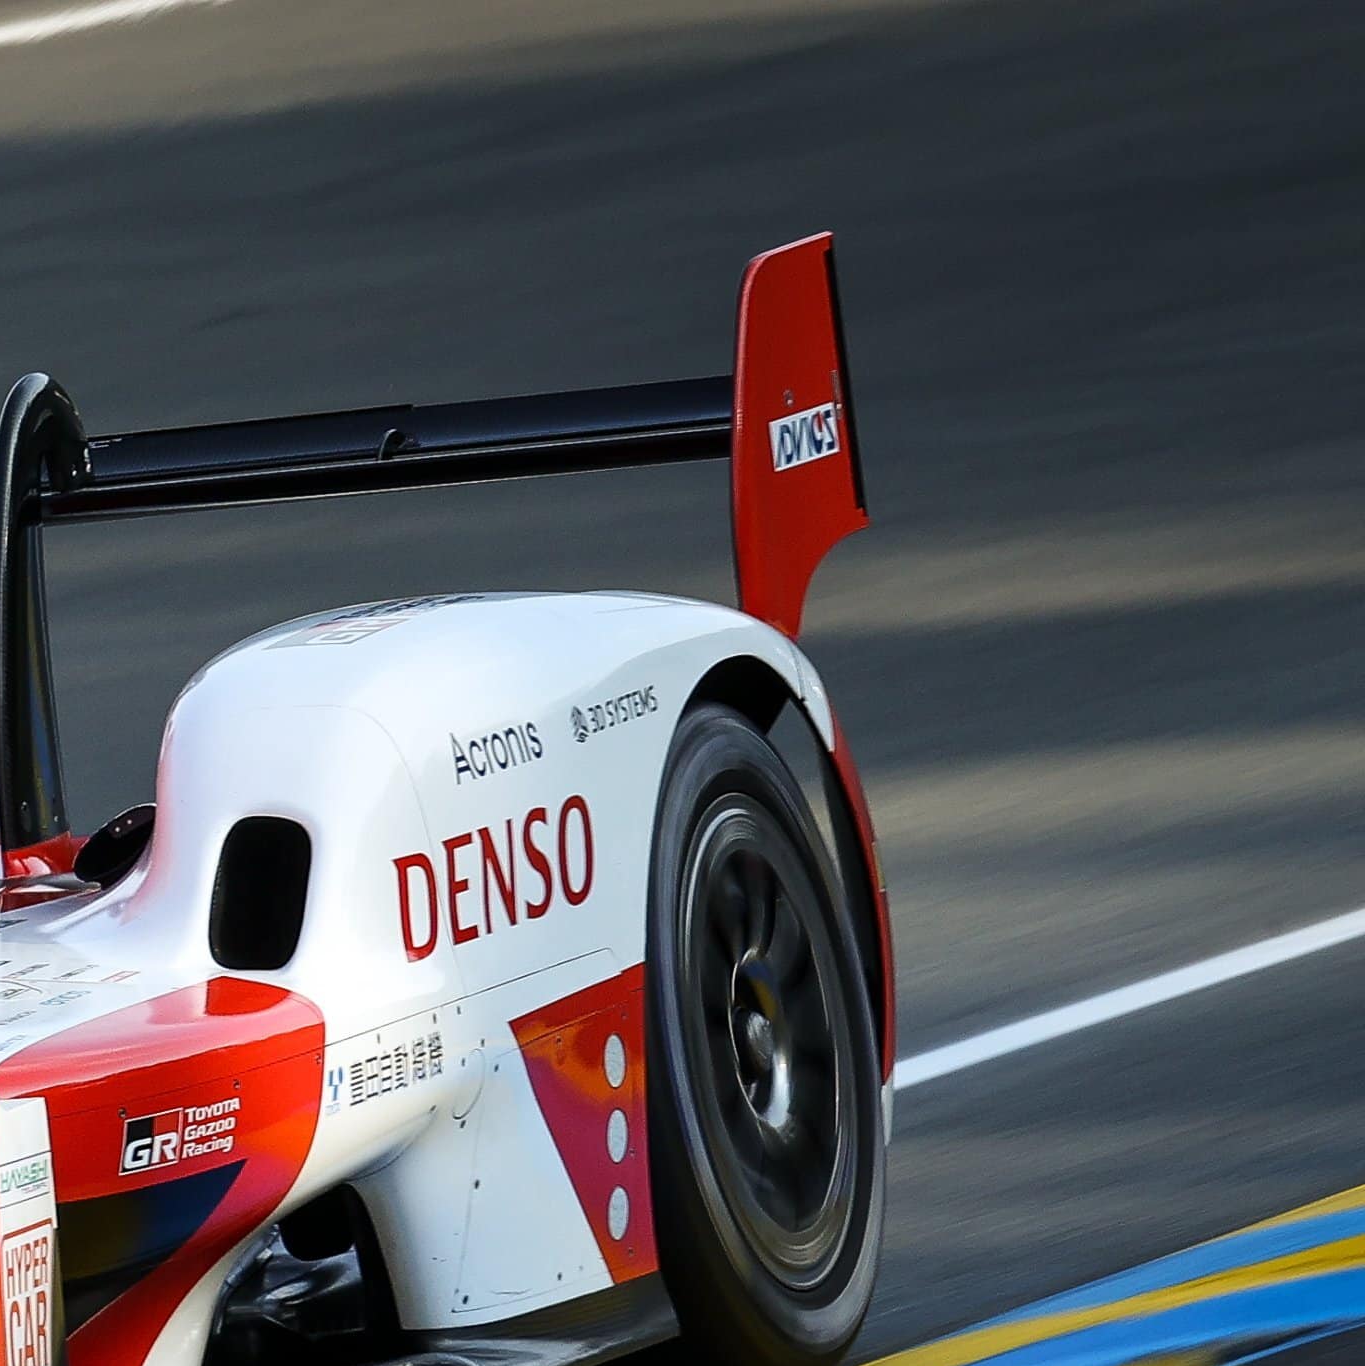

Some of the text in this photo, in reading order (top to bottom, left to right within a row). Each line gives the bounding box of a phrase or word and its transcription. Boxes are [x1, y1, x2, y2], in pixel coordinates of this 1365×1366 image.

[605, 685, 659, 728] SYSTEMS
[450, 722, 543, 785] Acronis
[391, 795, 594, 962] DENSO
[184, 1098, 241, 1122] TOYOTA
[184, 1117, 236, 1140] GAZOO
[124, 1132, 179, 1169] GR
[182, 1136, 234, 1158] Racing
[6, 1237, 48, 1299] HYPER
